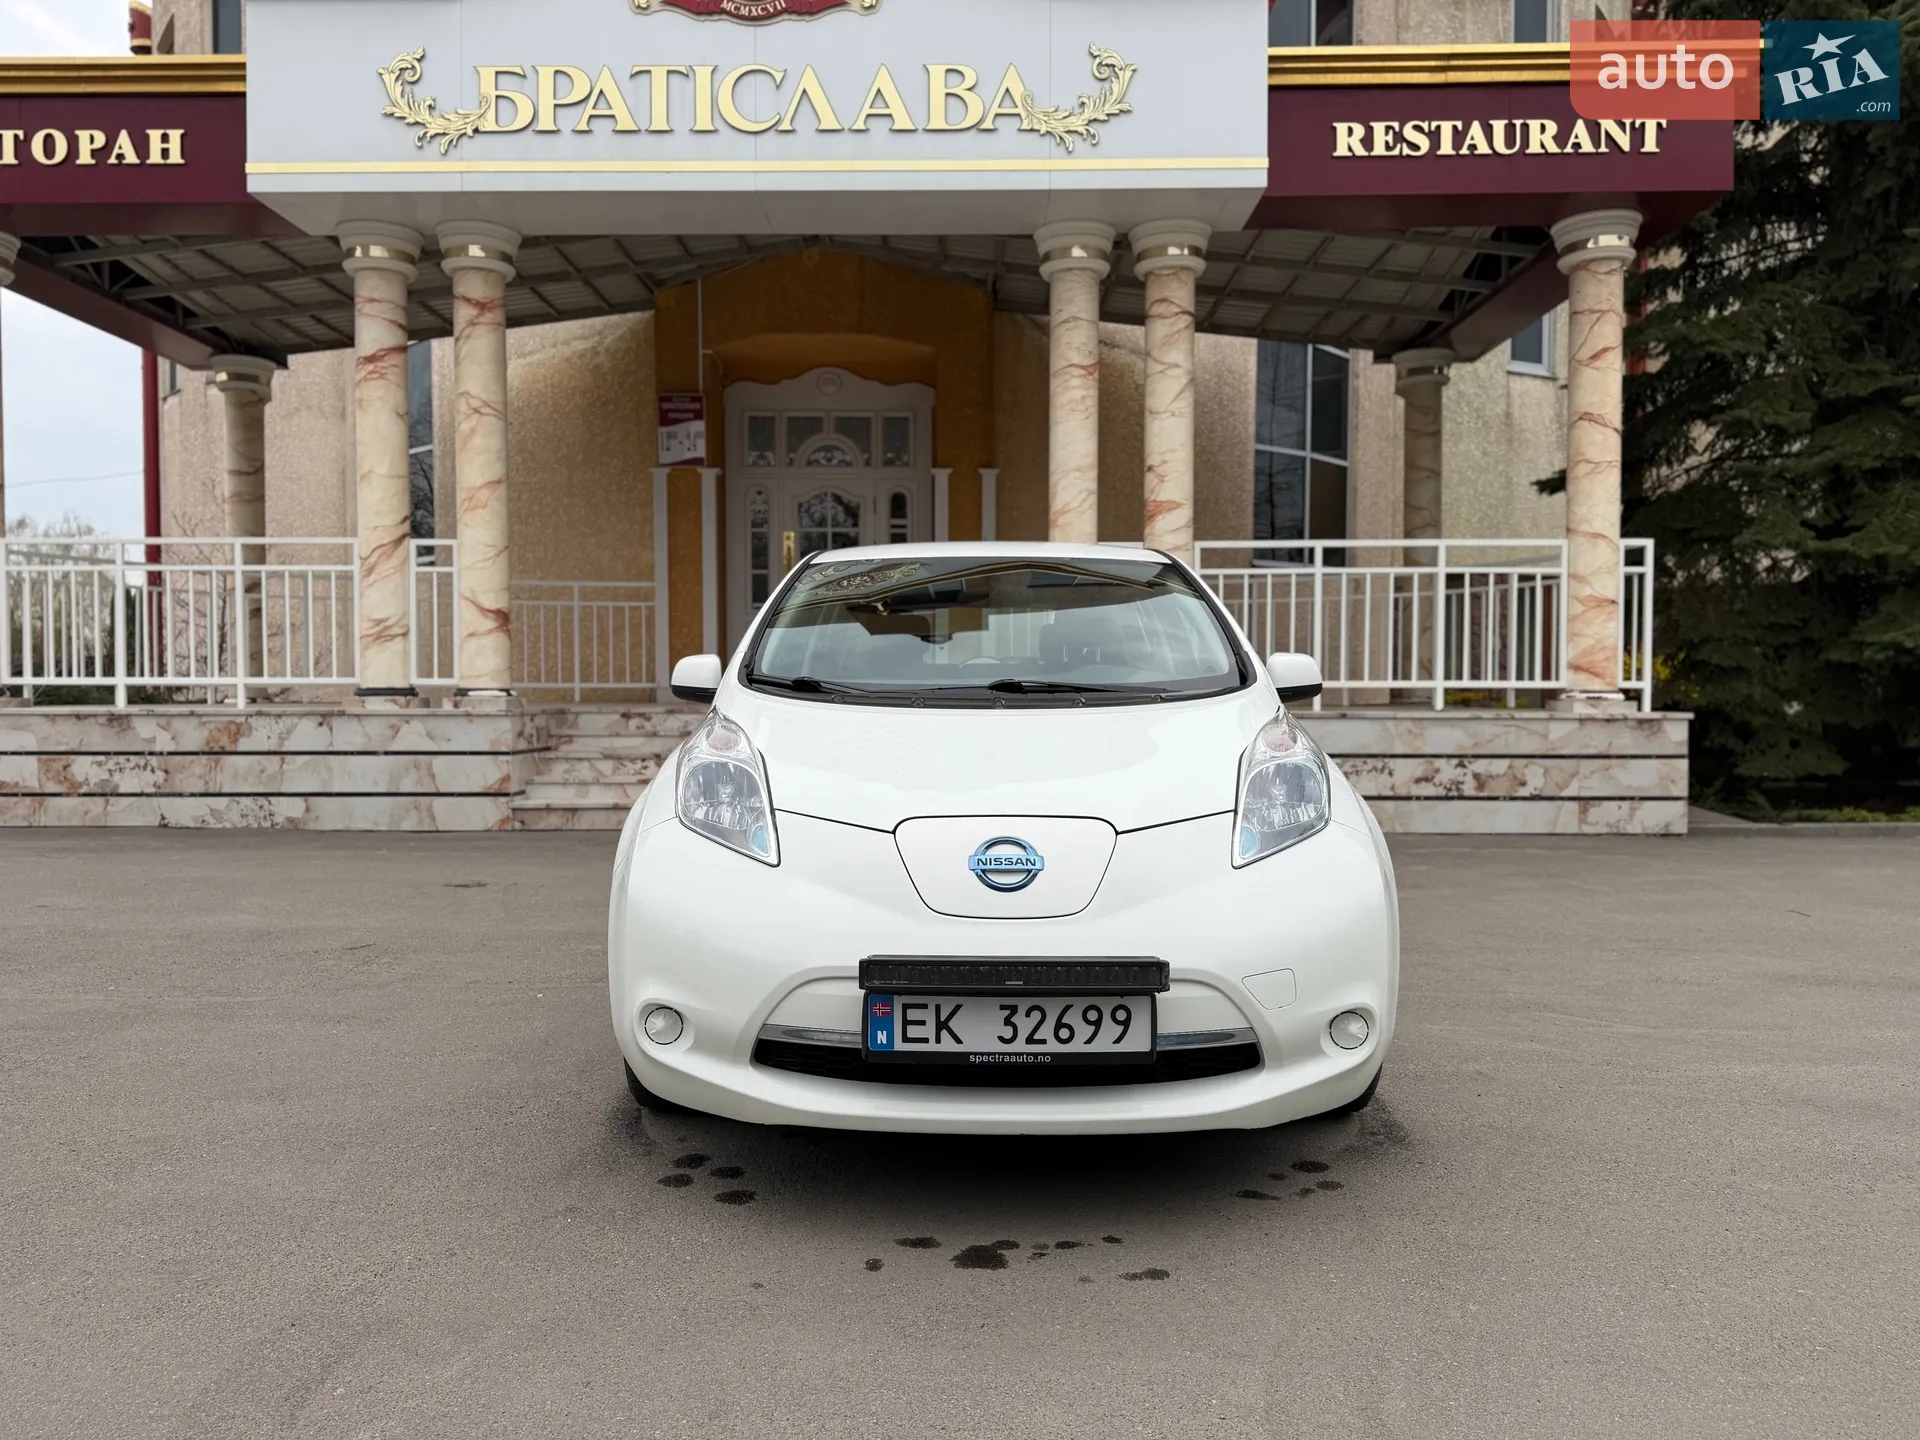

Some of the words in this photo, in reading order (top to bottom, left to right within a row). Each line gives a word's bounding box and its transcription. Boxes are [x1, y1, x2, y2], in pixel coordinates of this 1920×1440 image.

[719, 0, 787, 17] MCMXCVII
[474, 63, 1034, 134] БРАТІСЛАВА
[1331, 118, 1668, 158] RESTAURANT
[977, 857, 1036, 867] NISSAN
[901, 1003, 964, 1045] EK
[997, 1004, 1133, 1045] 32699
[876, 1030, 887, 1044] N
[969, 1054, 1052, 1064] spectraauto.no
